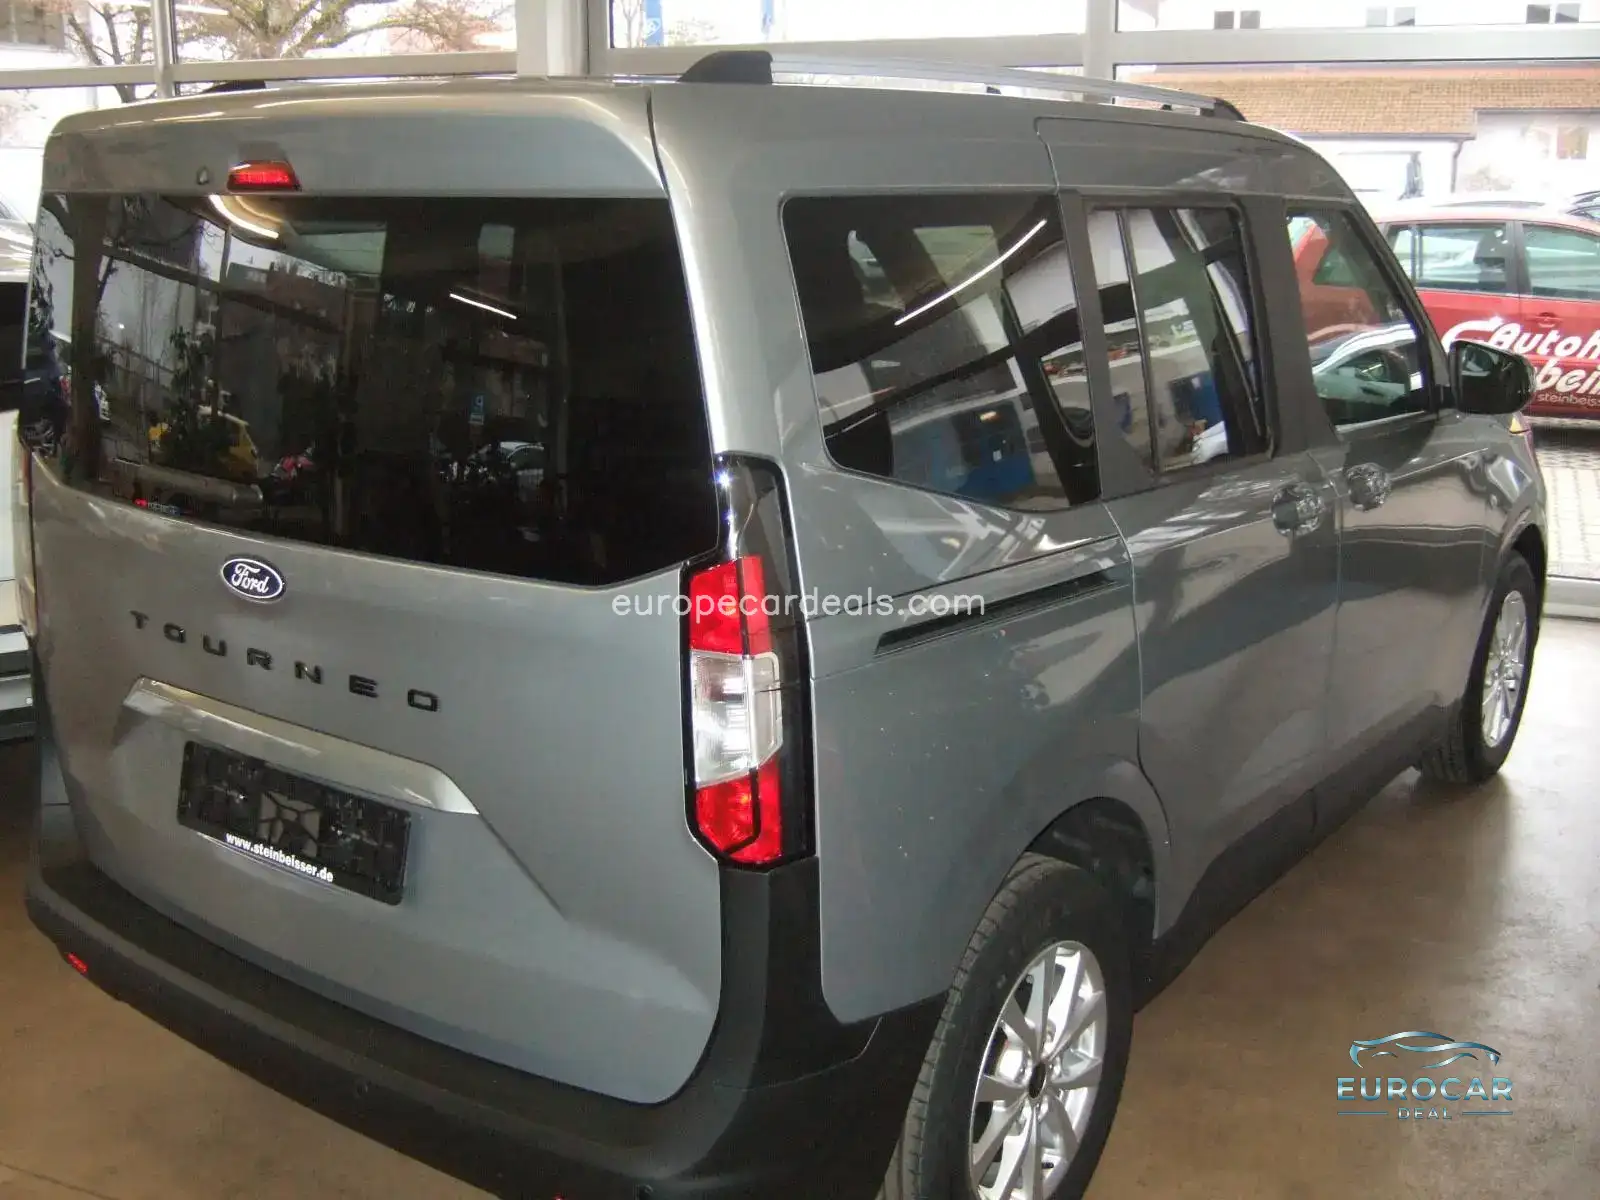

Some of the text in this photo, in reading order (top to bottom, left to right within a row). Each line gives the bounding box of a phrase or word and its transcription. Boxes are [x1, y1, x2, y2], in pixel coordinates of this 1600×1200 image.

[1537, 391, 1600, 407] steinbeis
[231, 562, 270, 594] Ford
[131, 610, 439, 712] TOURNEO
[225, 832, 334, 883] www.steinbeisser.de
